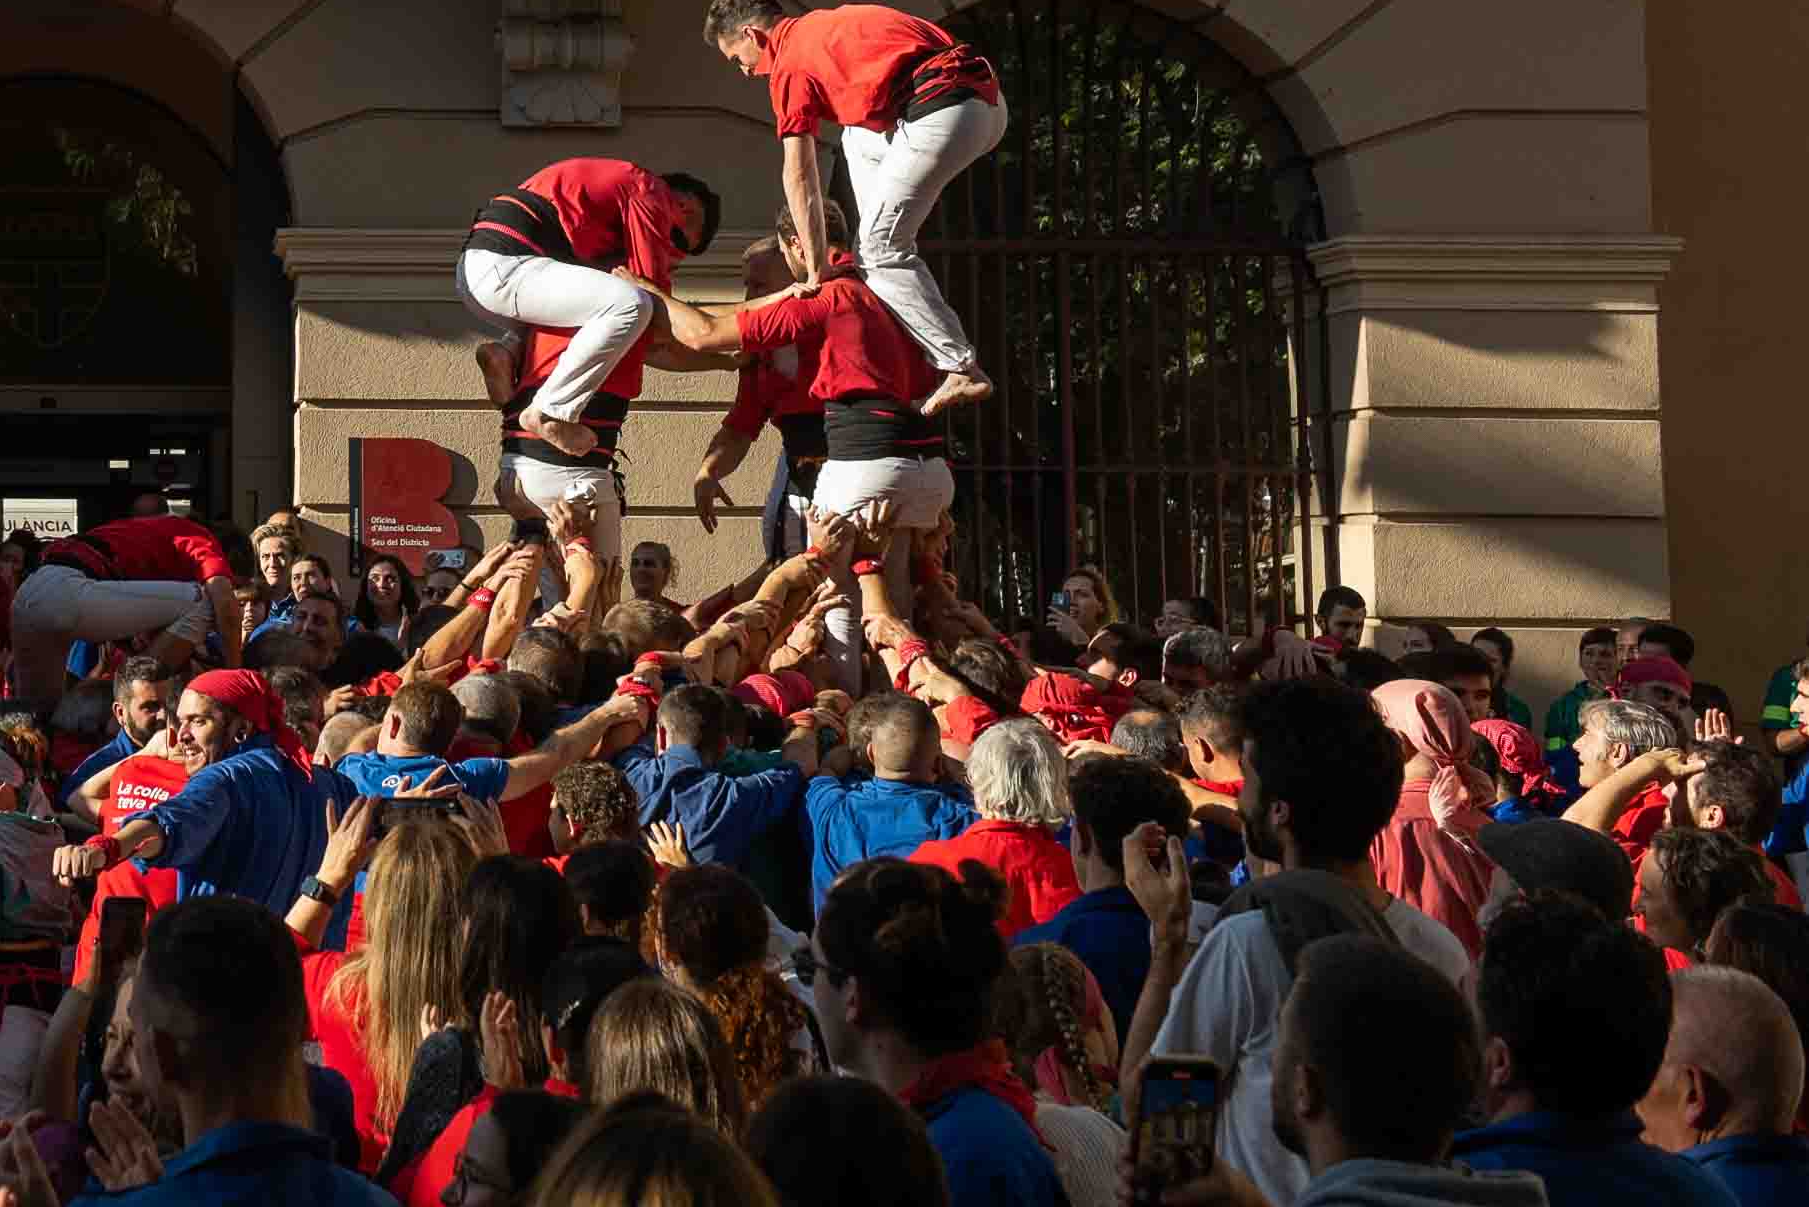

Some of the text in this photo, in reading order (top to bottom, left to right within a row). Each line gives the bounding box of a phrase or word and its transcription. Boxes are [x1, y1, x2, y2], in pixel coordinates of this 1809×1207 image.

[371, 516, 396, 524] Oficina
[406, 524, 442, 532] Ciutadana
[371, 538, 385, 546] Seu
[387, 538, 398, 546] del
[117, 780, 169, 801] La colla
